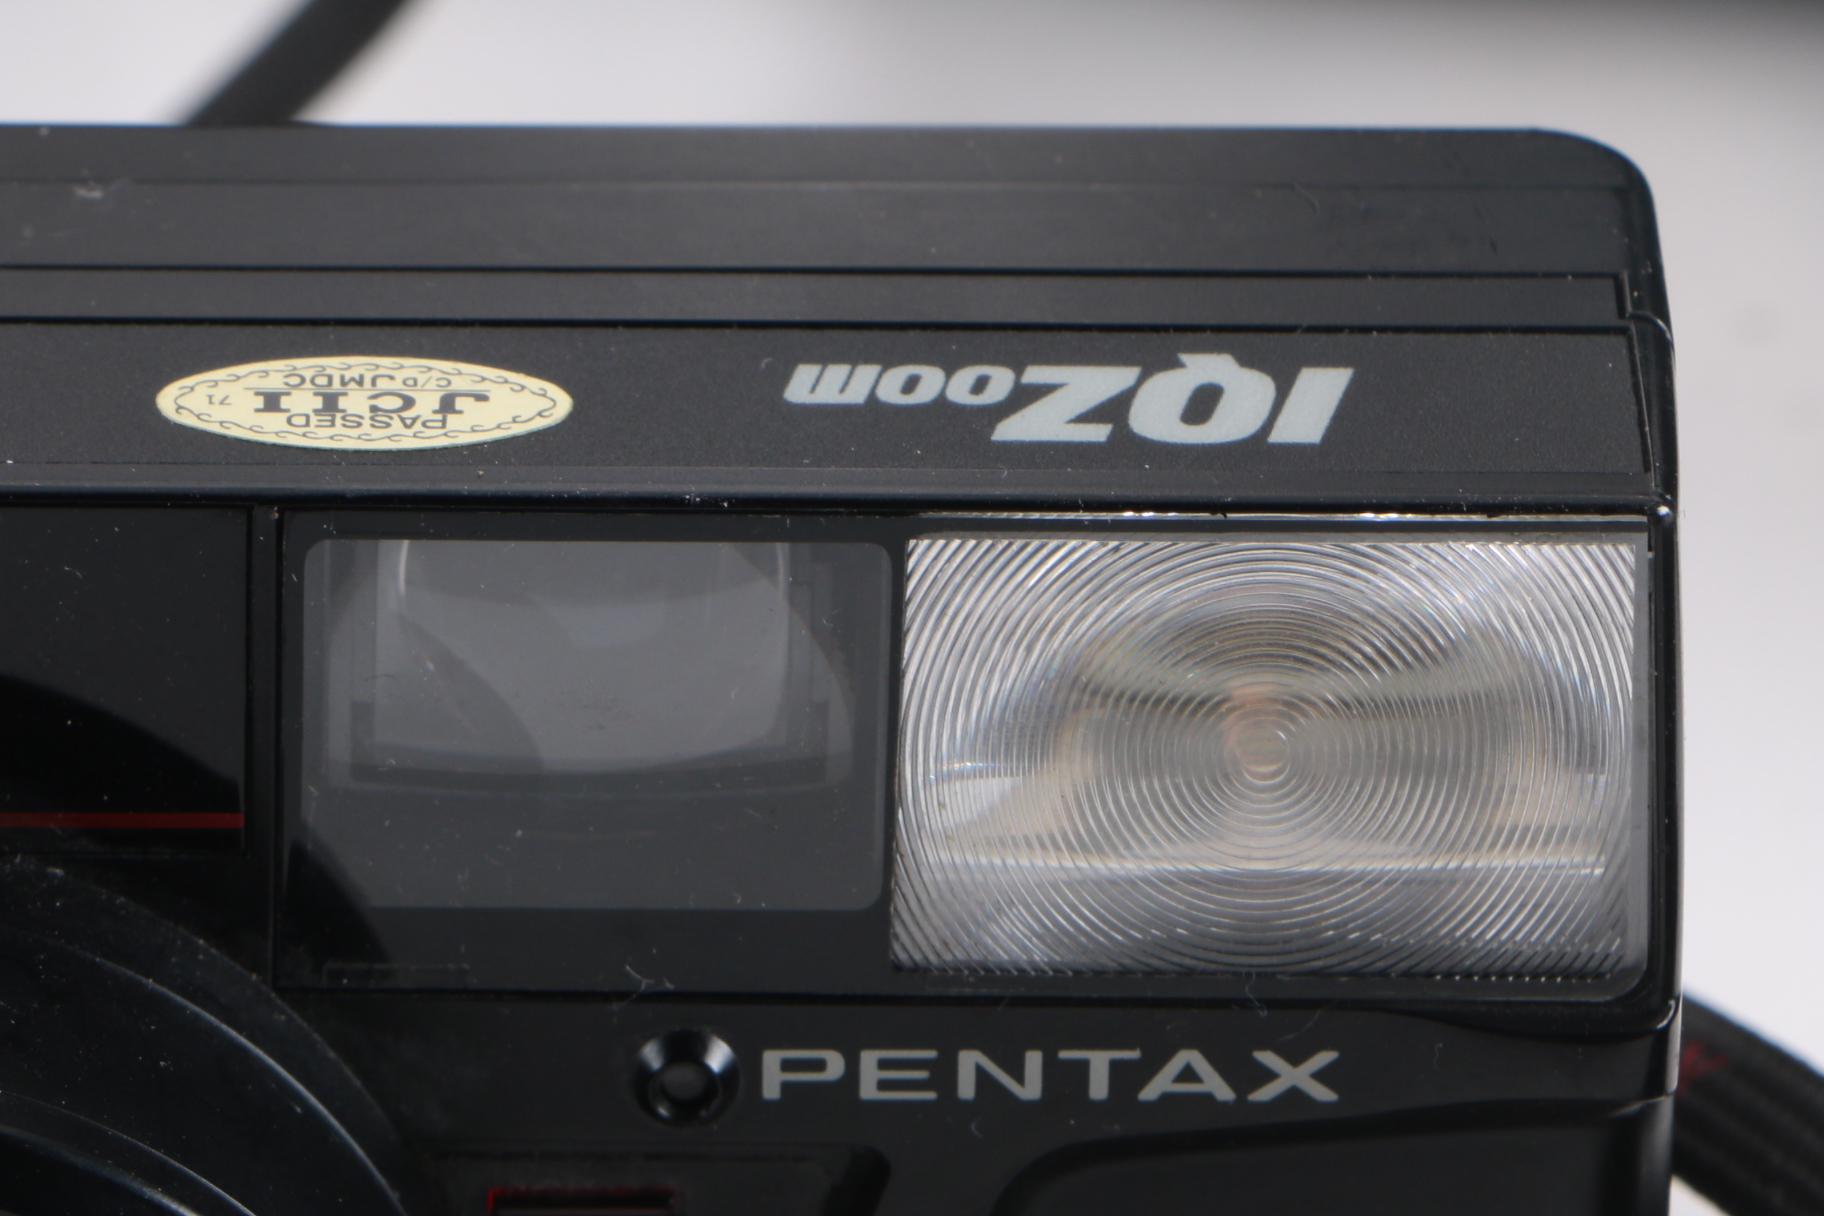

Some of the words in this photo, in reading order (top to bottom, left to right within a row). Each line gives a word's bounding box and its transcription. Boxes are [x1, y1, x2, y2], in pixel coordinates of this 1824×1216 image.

[283, 373, 400, 388] JMDC
[253, 391, 491, 415] JCII
[286, 413, 448, 430] PASSED
[760, 1048, 1340, 1102] PENTAX
